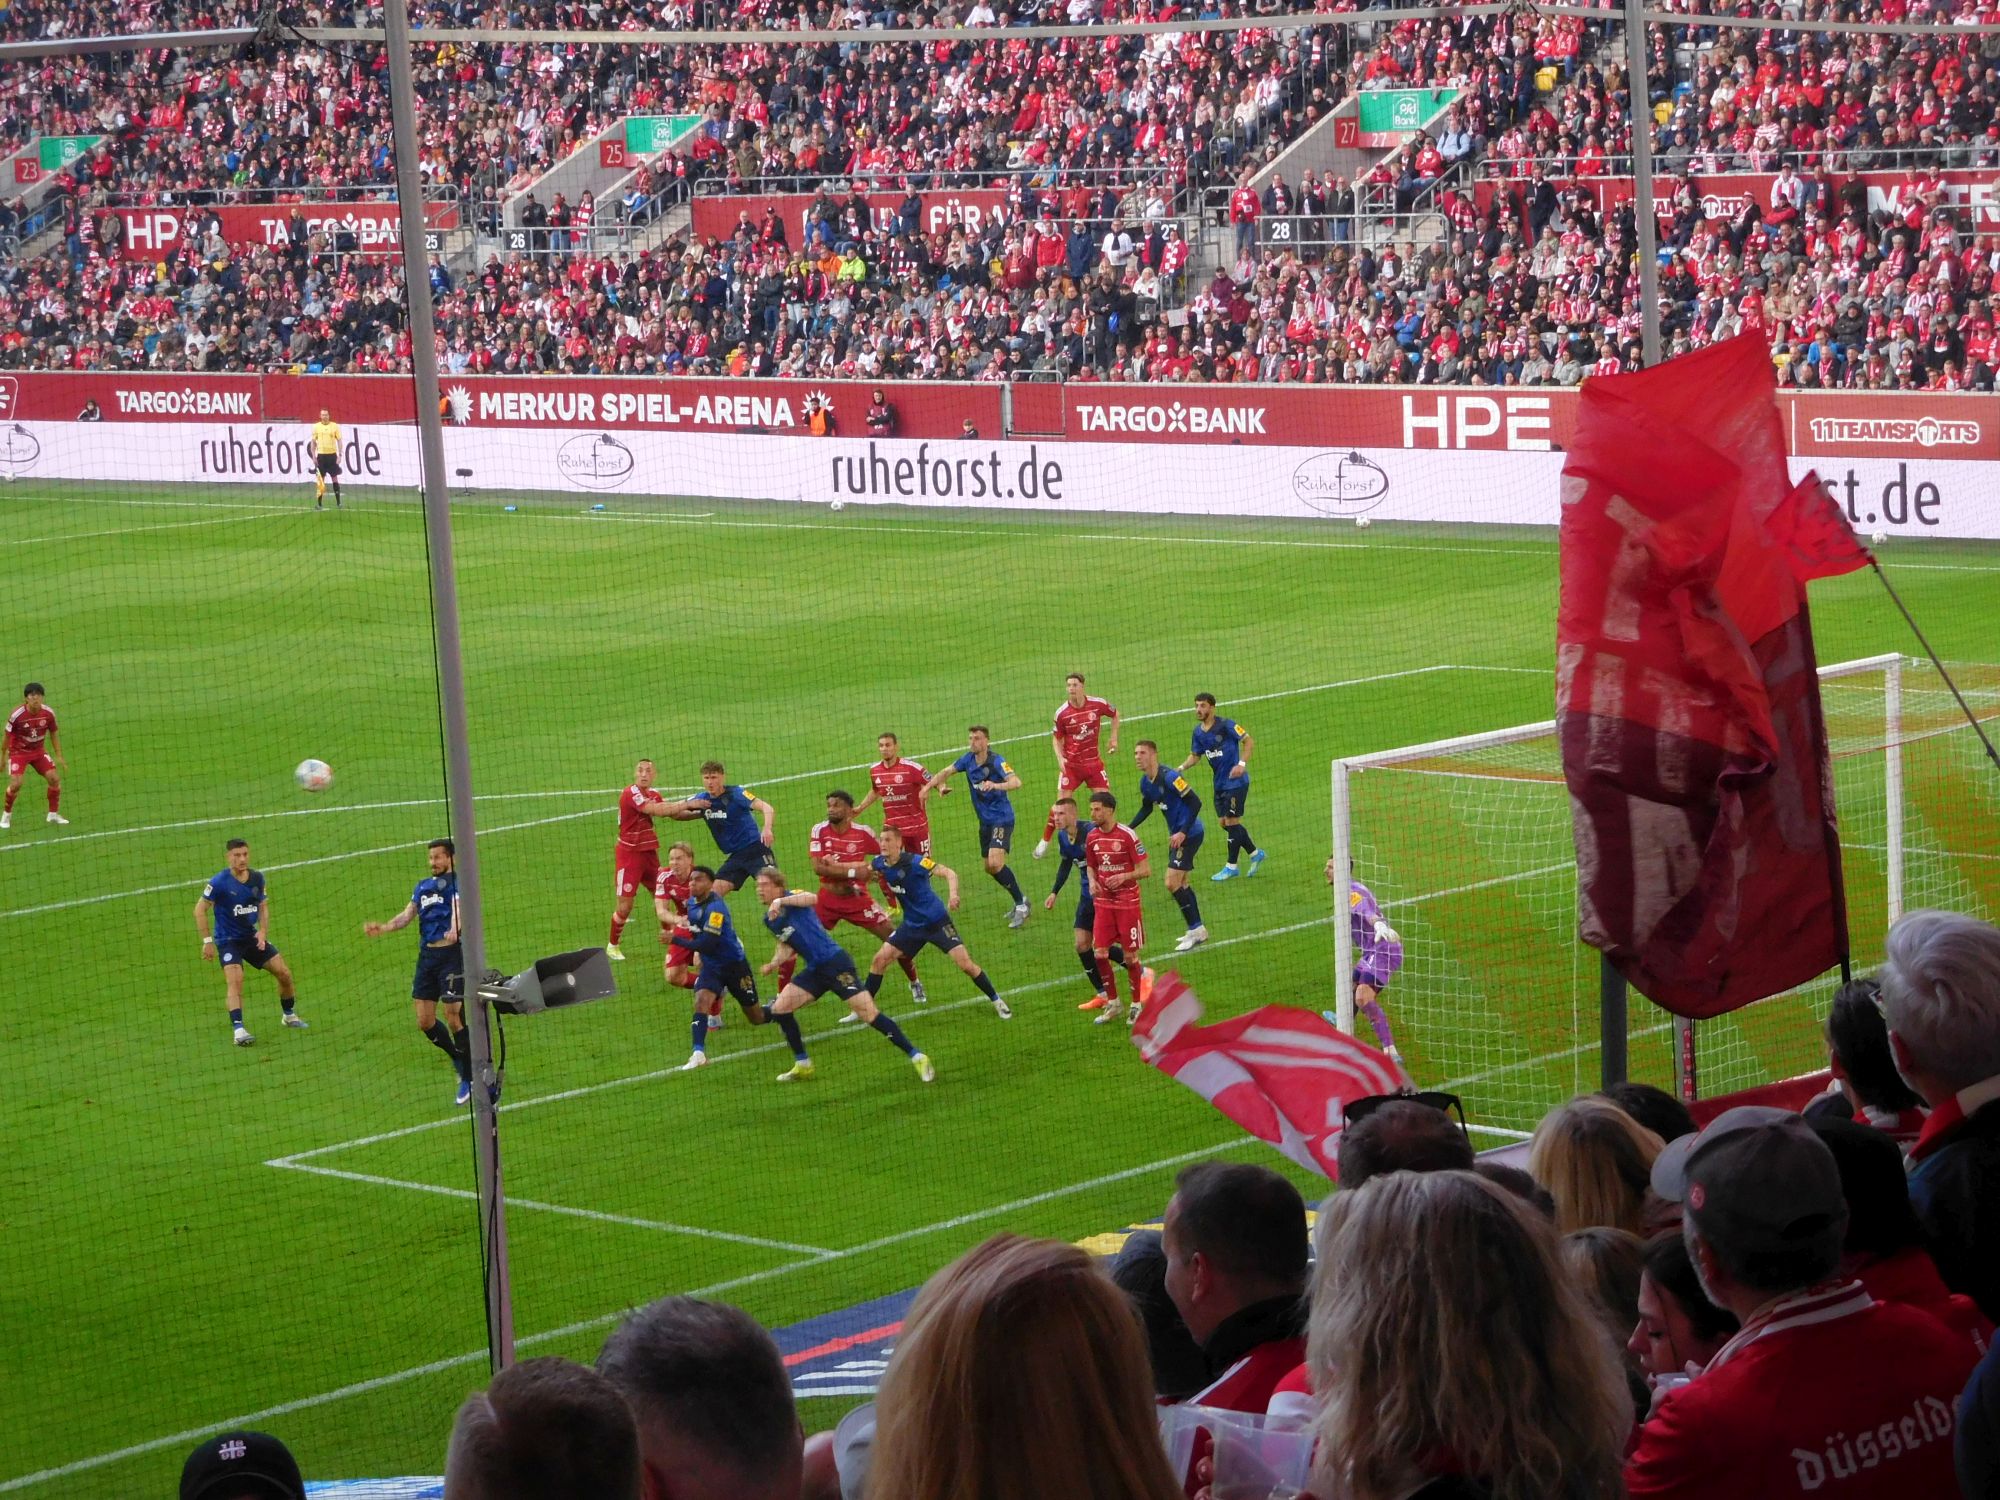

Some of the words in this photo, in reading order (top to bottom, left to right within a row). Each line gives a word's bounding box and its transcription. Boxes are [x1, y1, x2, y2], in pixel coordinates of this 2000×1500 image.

[1340, 122, 1356, 144] 27
[1371, 132, 1387, 147] 27
[606, 144, 623, 164] 25
[21, 162, 38, 180] 23
[127, 214, 179, 250] HP
[510, 233, 526, 249] 26
[1271, 222, 1290, 240] 28
[115, 389, 252, 415] TARGOBANK
[480, 392, 595, 421] MERKUR
[601, 392, 795, 427] SPIEL-ARENA
[1076, 404, 1267, 434] TARGOBANK
[1402, 395, 1551, 450] HPE
[200, 426, 381, 476] ruhefors.de
[832, 441, 1063, 500] ruheforst.de
[1130, 927, 1138, 941] 8
